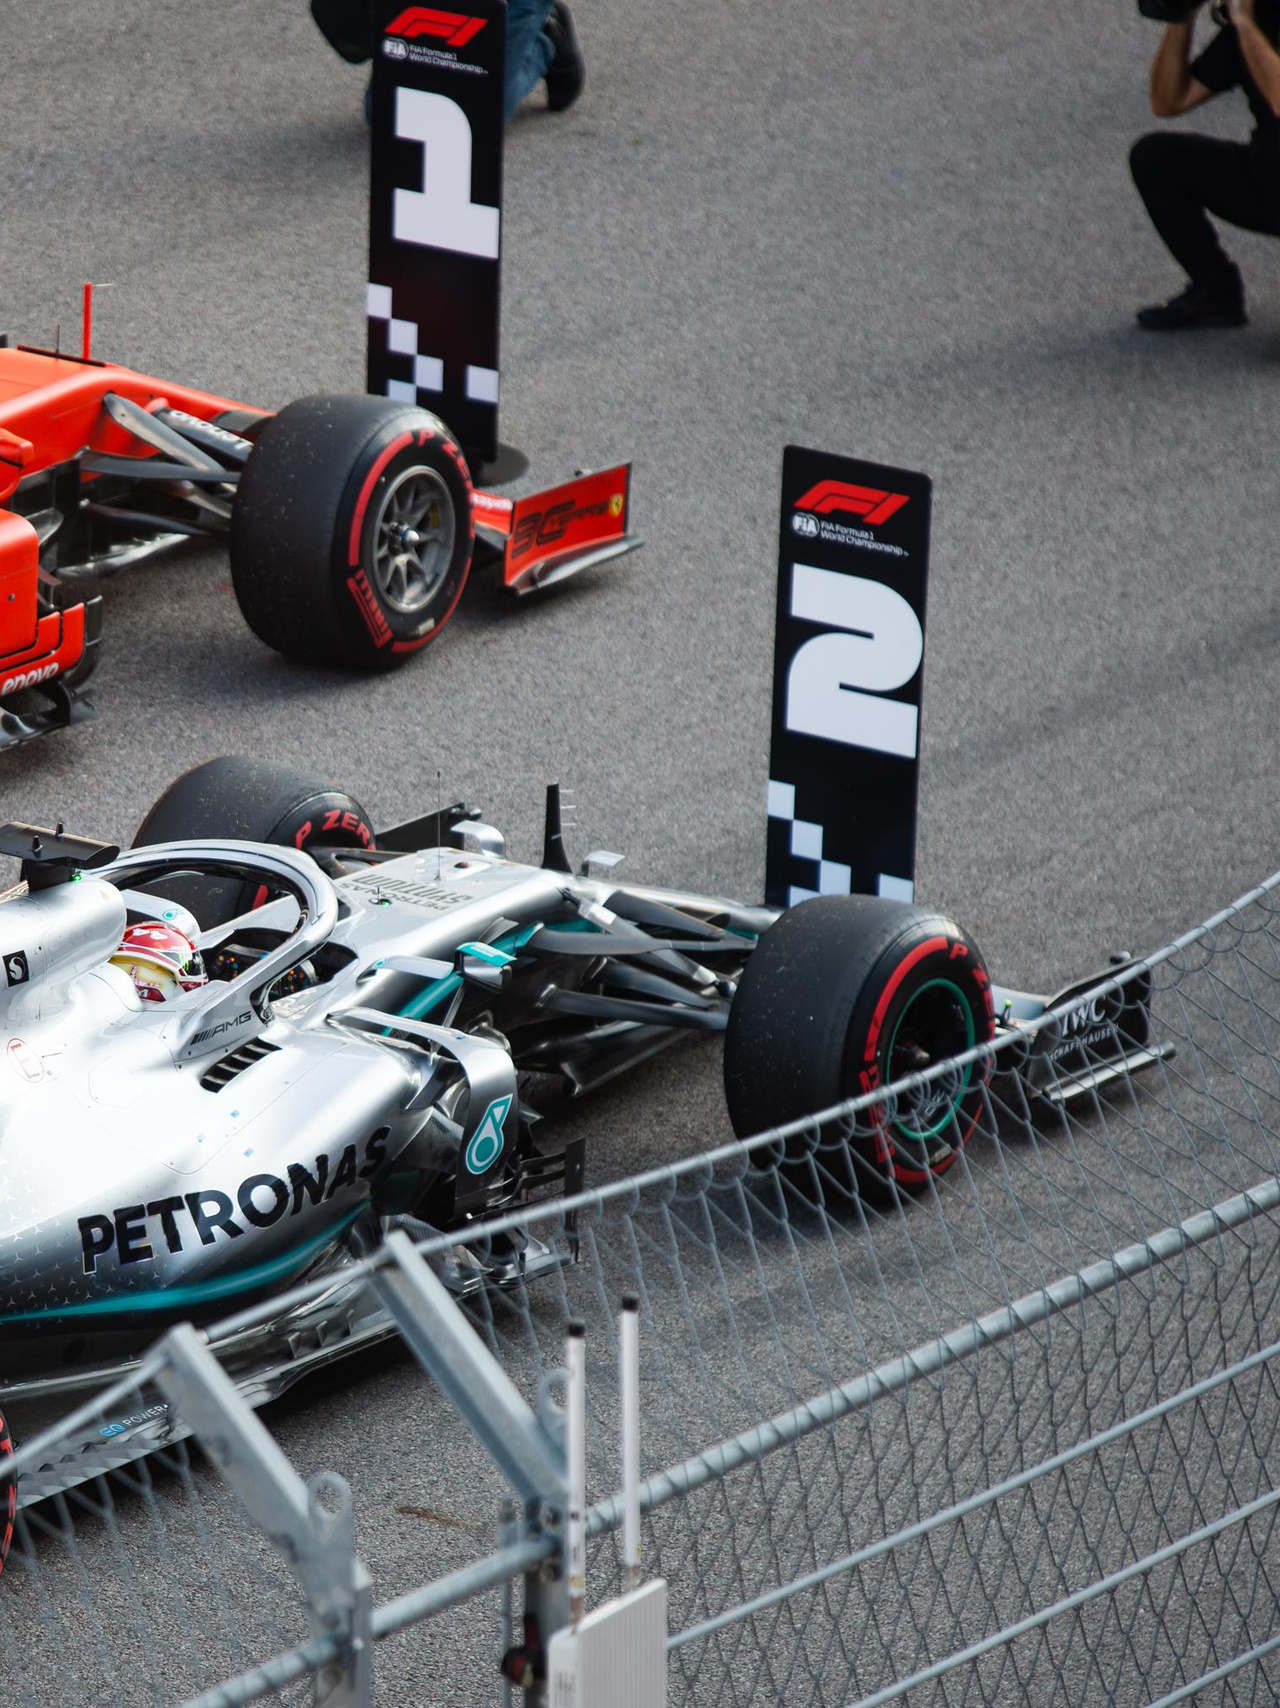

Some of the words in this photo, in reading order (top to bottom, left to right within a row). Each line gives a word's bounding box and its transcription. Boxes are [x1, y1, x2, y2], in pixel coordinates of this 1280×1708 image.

[410, 52, 432, 64] World
[432, 56, 484, 74] Championship
[423, 46, 452, 60] Formula
[394, 85, 500, 259] 1
[821, 530, 845, 544] World
[846, 534, 904, 556] Championship
[836, 522, 869, 540] Formula
[786, 562, 924, 760] 2
[211, 1010, 252, 1038] AMG
[76, 1125, 392, 1276] PETRONAS
